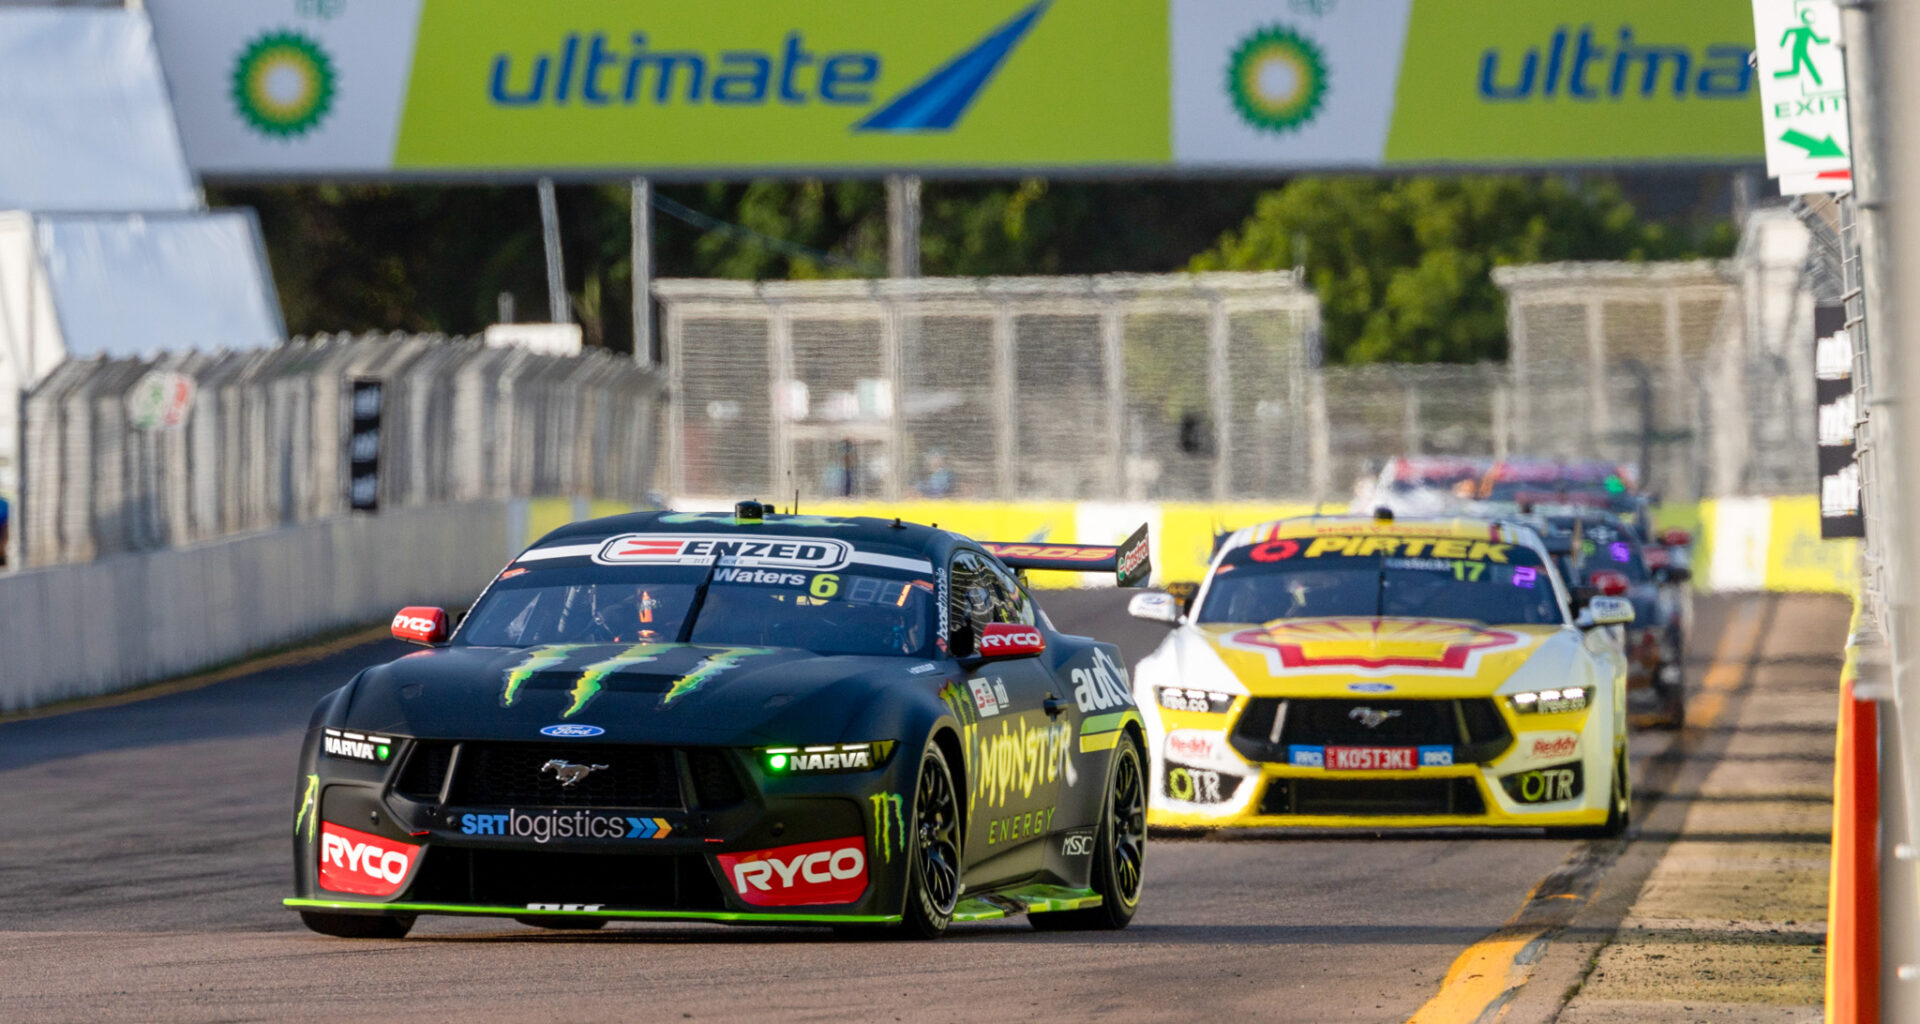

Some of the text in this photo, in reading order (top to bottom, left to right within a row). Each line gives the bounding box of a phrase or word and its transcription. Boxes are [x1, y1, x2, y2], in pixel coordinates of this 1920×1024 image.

[488, 30, 881, 106] ultimate
[1775, 97, 1845, 118] EXIT
[682, 541, 827, 560] ENZED
[1304, 536, 1513, 564] PIRTEK
[713, 567, 840, 598] Waters 6
[1450, 561, 1486, 582] 17
[392, 615, 436, 632] RYCO
[981, 632, 1041, 647] RYCO
[325, 737, 374, 759] NARVA
[790, 752, 869, 771] NARVA
[1169, 767, 1221, 802] OTR
[1521, 769, 1575, 801] OTR
[988, 807, 1056, 844] ENERGY
[1062, 835, 1093, 856] MSC
[322, 832, 409, 885] RYCO
[733, 847, 865, 894] RYCO
